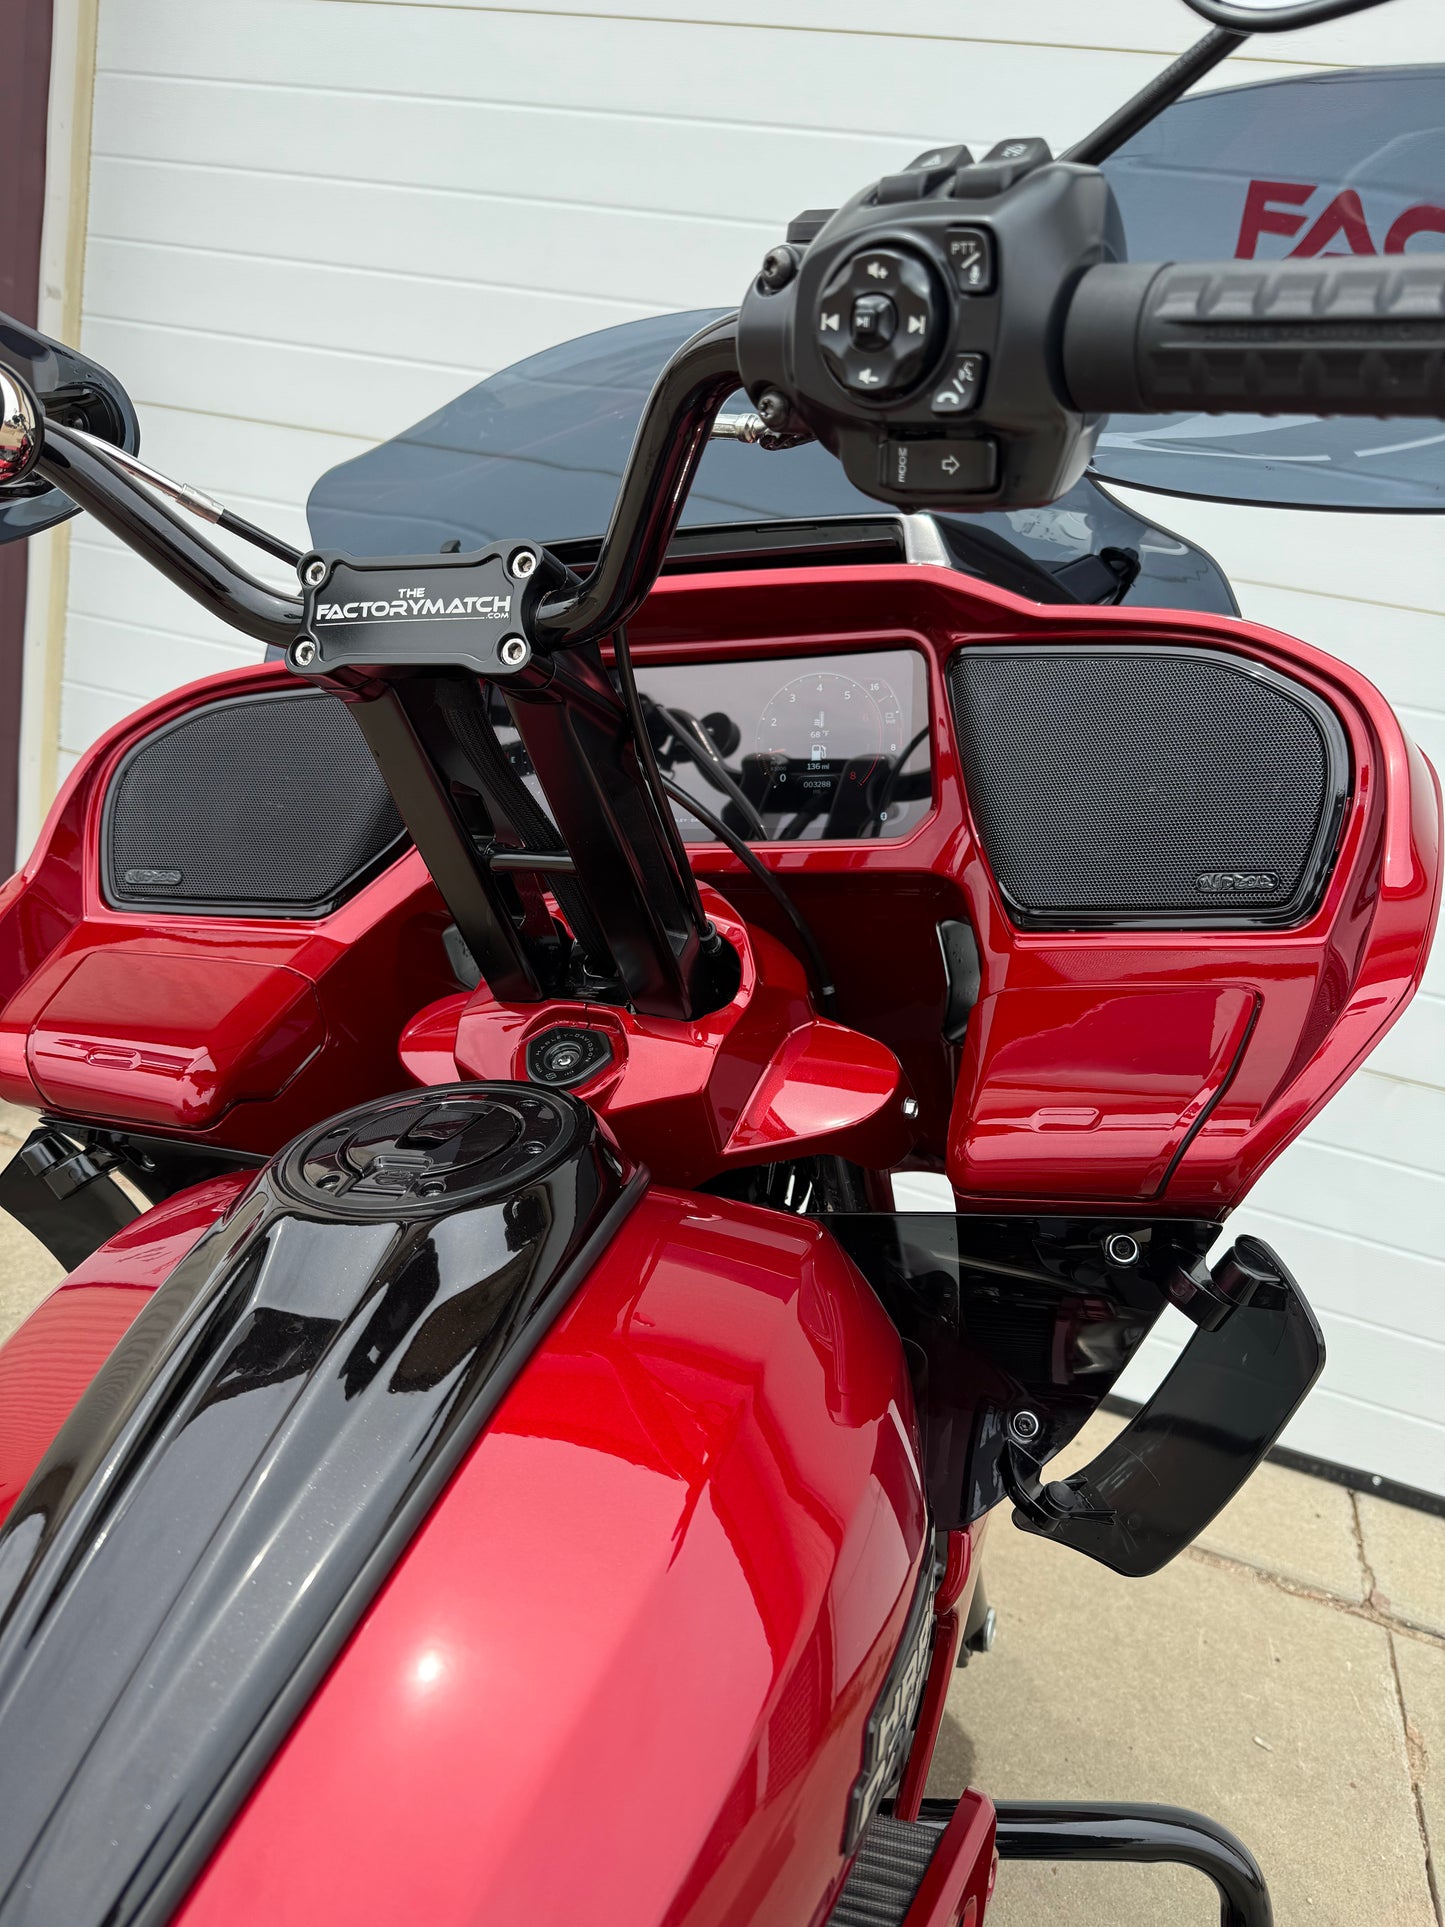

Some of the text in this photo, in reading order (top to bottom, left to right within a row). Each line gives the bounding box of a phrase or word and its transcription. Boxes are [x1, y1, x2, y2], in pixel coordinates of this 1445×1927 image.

[951, 241, 977, 255] PTT
[898, 447, 908, 483] MODE
[398, 587, 426, 599] THE
[316, 595, 512, 621] FACTORYMATCH
[485, 612, 510, 621] .COM
[816, 683, 824, 692] 4
[870, 683, 880, 691] 16
[789, 693, 796, 703] 3
[843, 690, 851, 700] 5
[770, 718, 777, 727] 2
[810, 731, 821, 739] 68
[890, 743, 897, 752] 8
[807, 762, 830, 770] 136 mi
[779, 773, 787, 783] 0
[849, 771, 857, 780] 8
